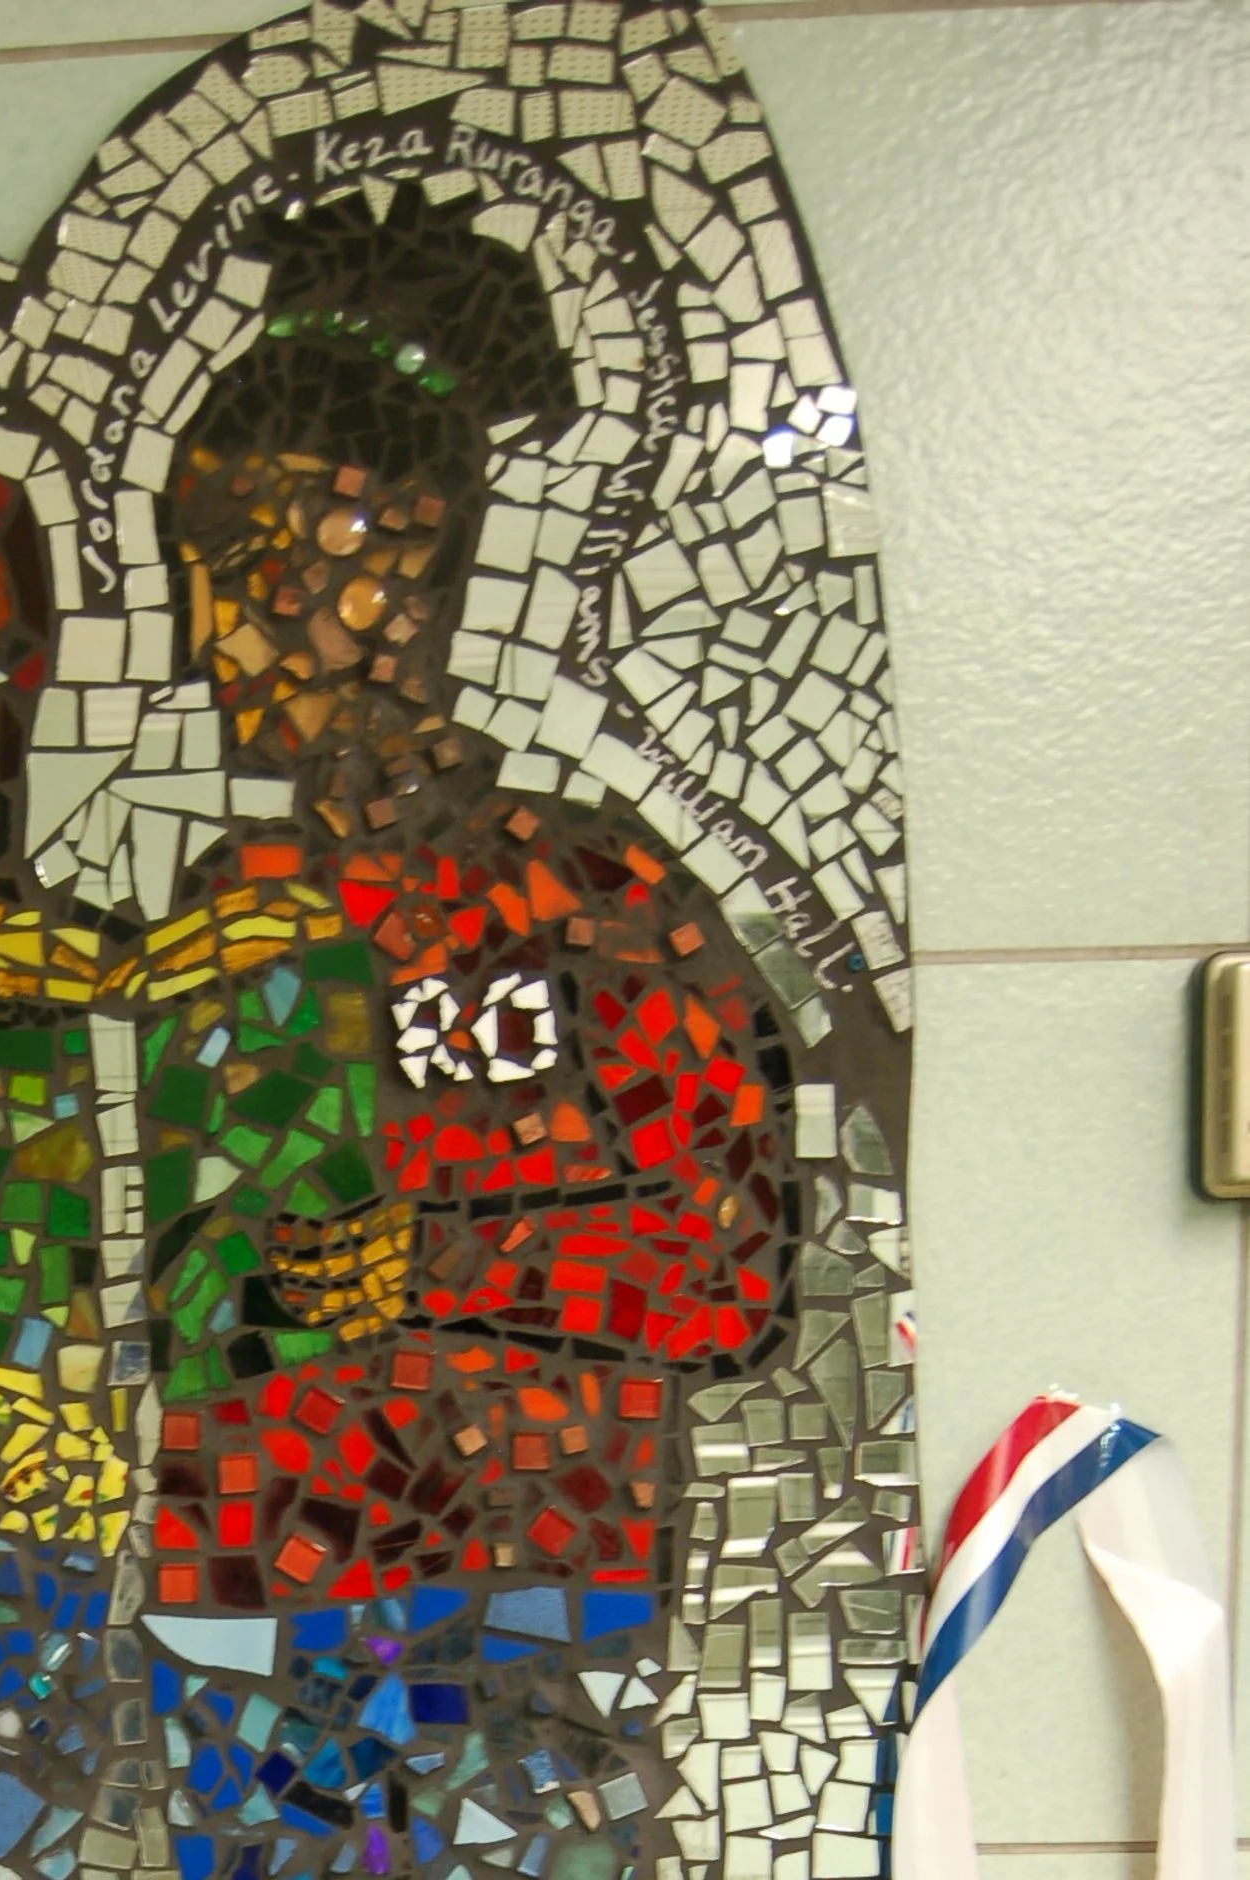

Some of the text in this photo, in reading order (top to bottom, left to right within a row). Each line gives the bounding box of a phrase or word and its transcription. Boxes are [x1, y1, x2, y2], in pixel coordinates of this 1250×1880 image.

[312, 124, 619, 255] Keza Ruranga
[81, 173, 281, 594] Jordana Levine
[576, 459, 652, 686] Williams
[637, 726, 769, 872] William
